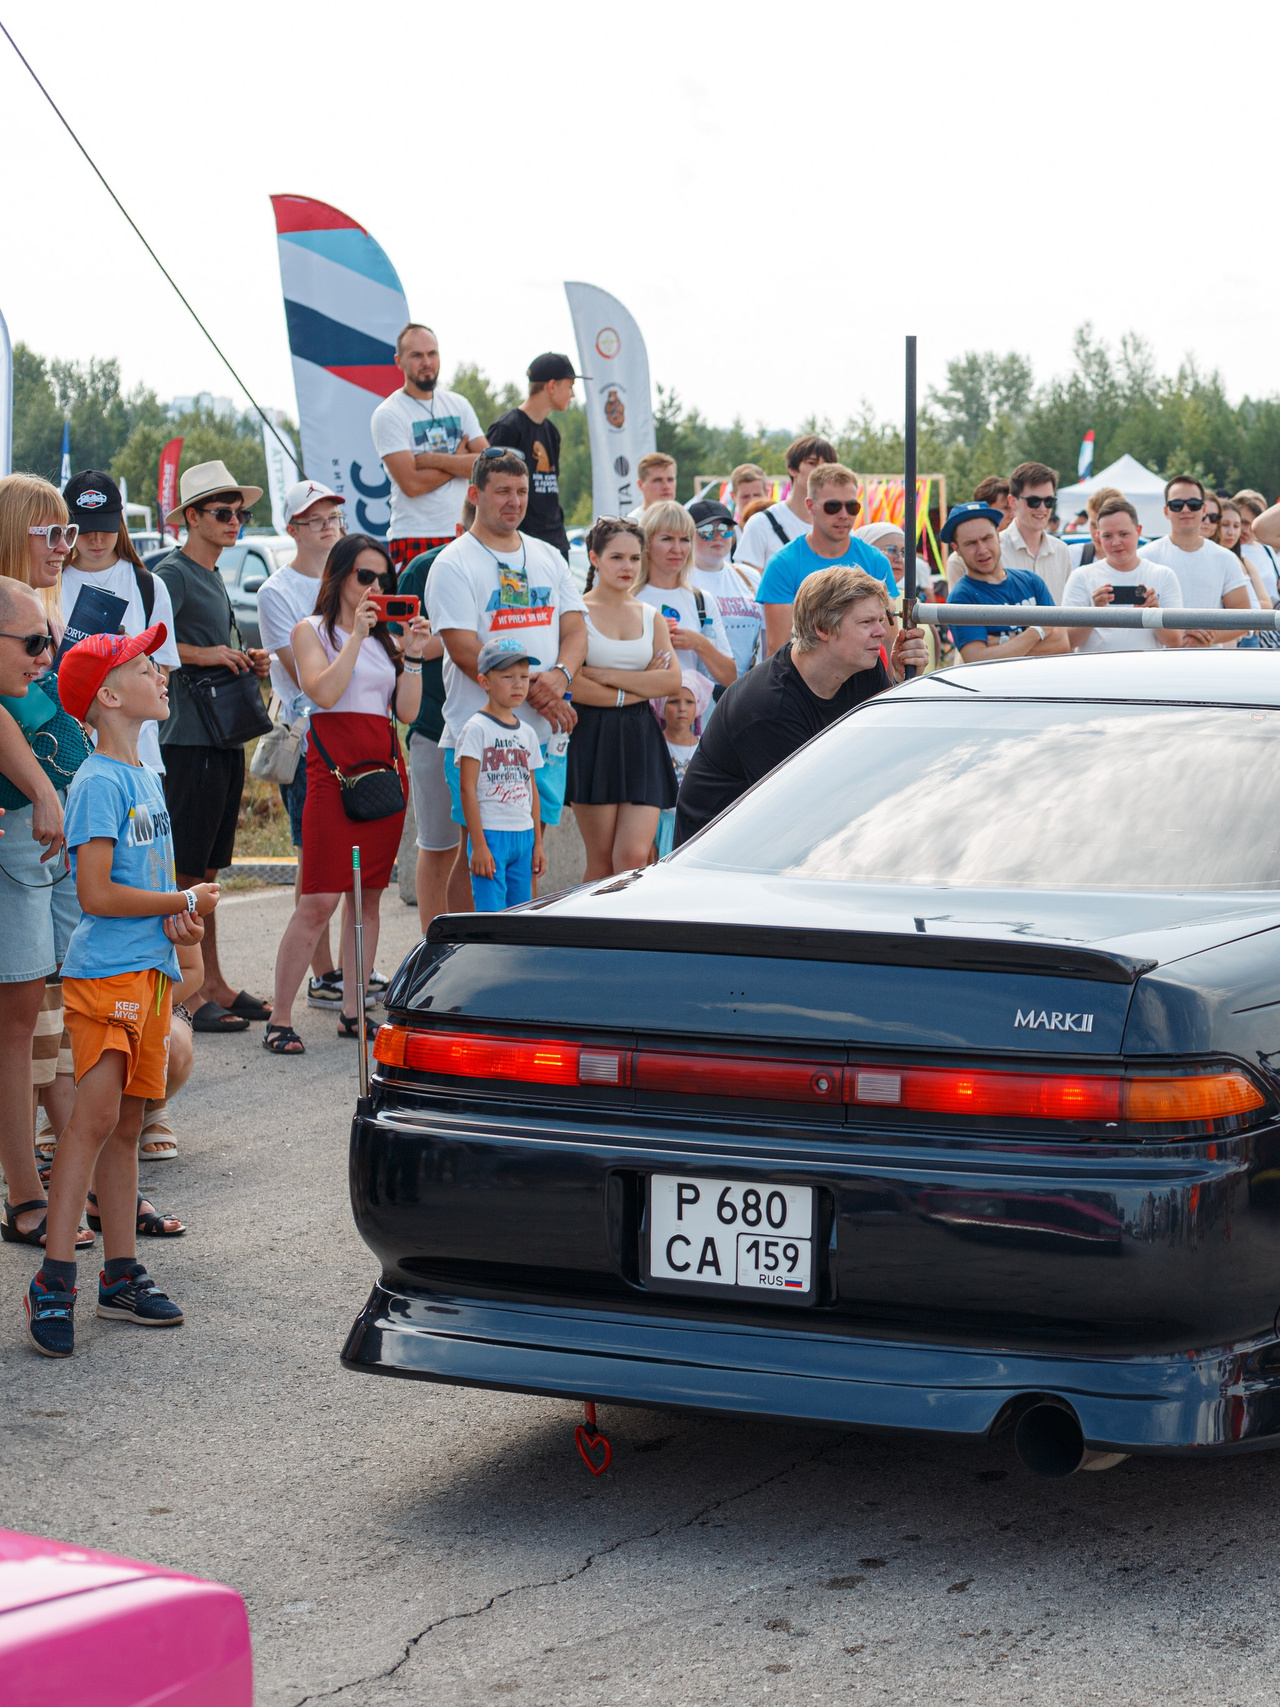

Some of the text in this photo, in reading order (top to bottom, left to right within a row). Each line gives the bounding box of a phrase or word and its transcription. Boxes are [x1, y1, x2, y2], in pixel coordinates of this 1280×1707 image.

[115, 1001, 140, 1012] KEEP
[676, 1182, 788, 1229] P 680
[665, 1233, 800, 1276] CA 159
[759, 1273, 784, 1287] RUS
